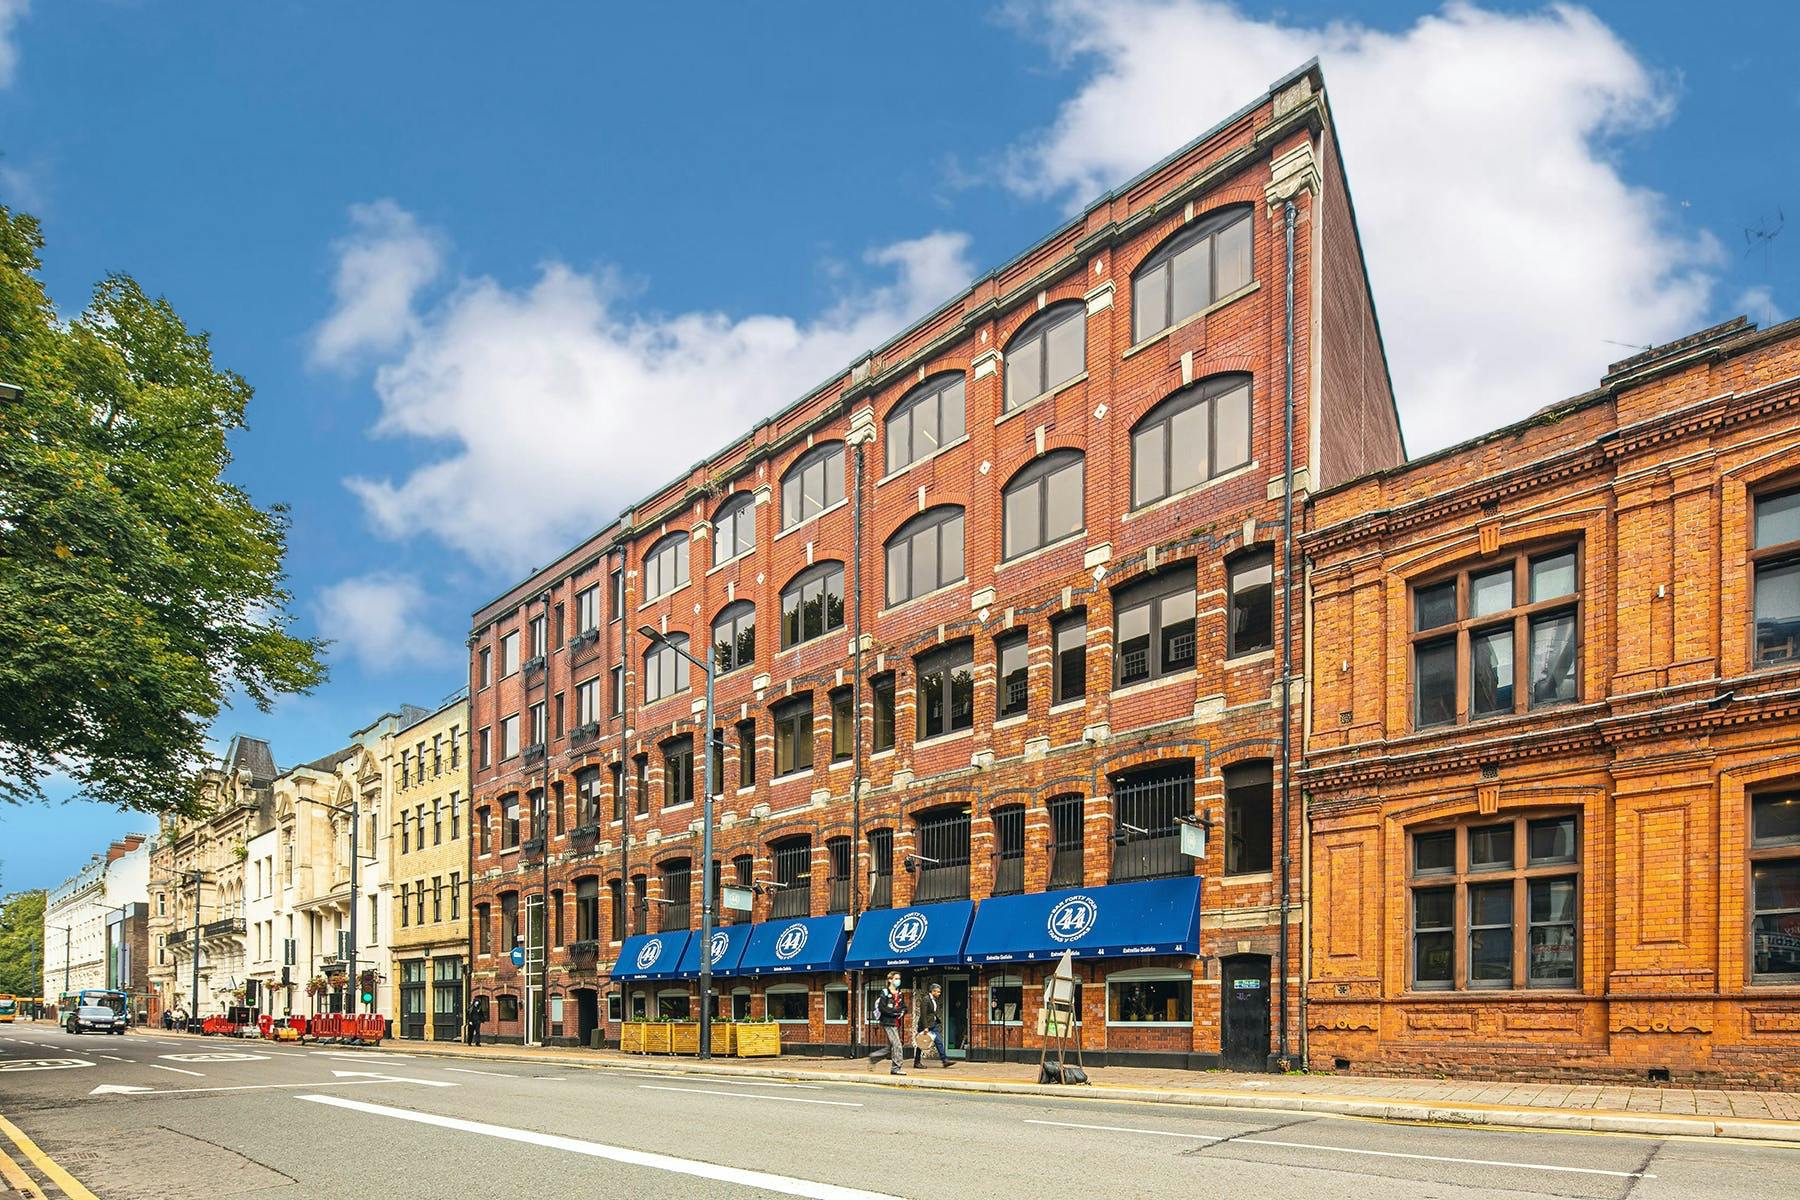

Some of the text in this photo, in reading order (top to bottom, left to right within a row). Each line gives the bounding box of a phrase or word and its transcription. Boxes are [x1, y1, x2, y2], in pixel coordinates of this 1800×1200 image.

[1064, 895, 1087, 904] FORTY
[1055, 906, 1086, 930] 44
[780, 932, 802, 950] 44
[894, 922, 920, 942] 44
[641, 946, 658, 962] 44
